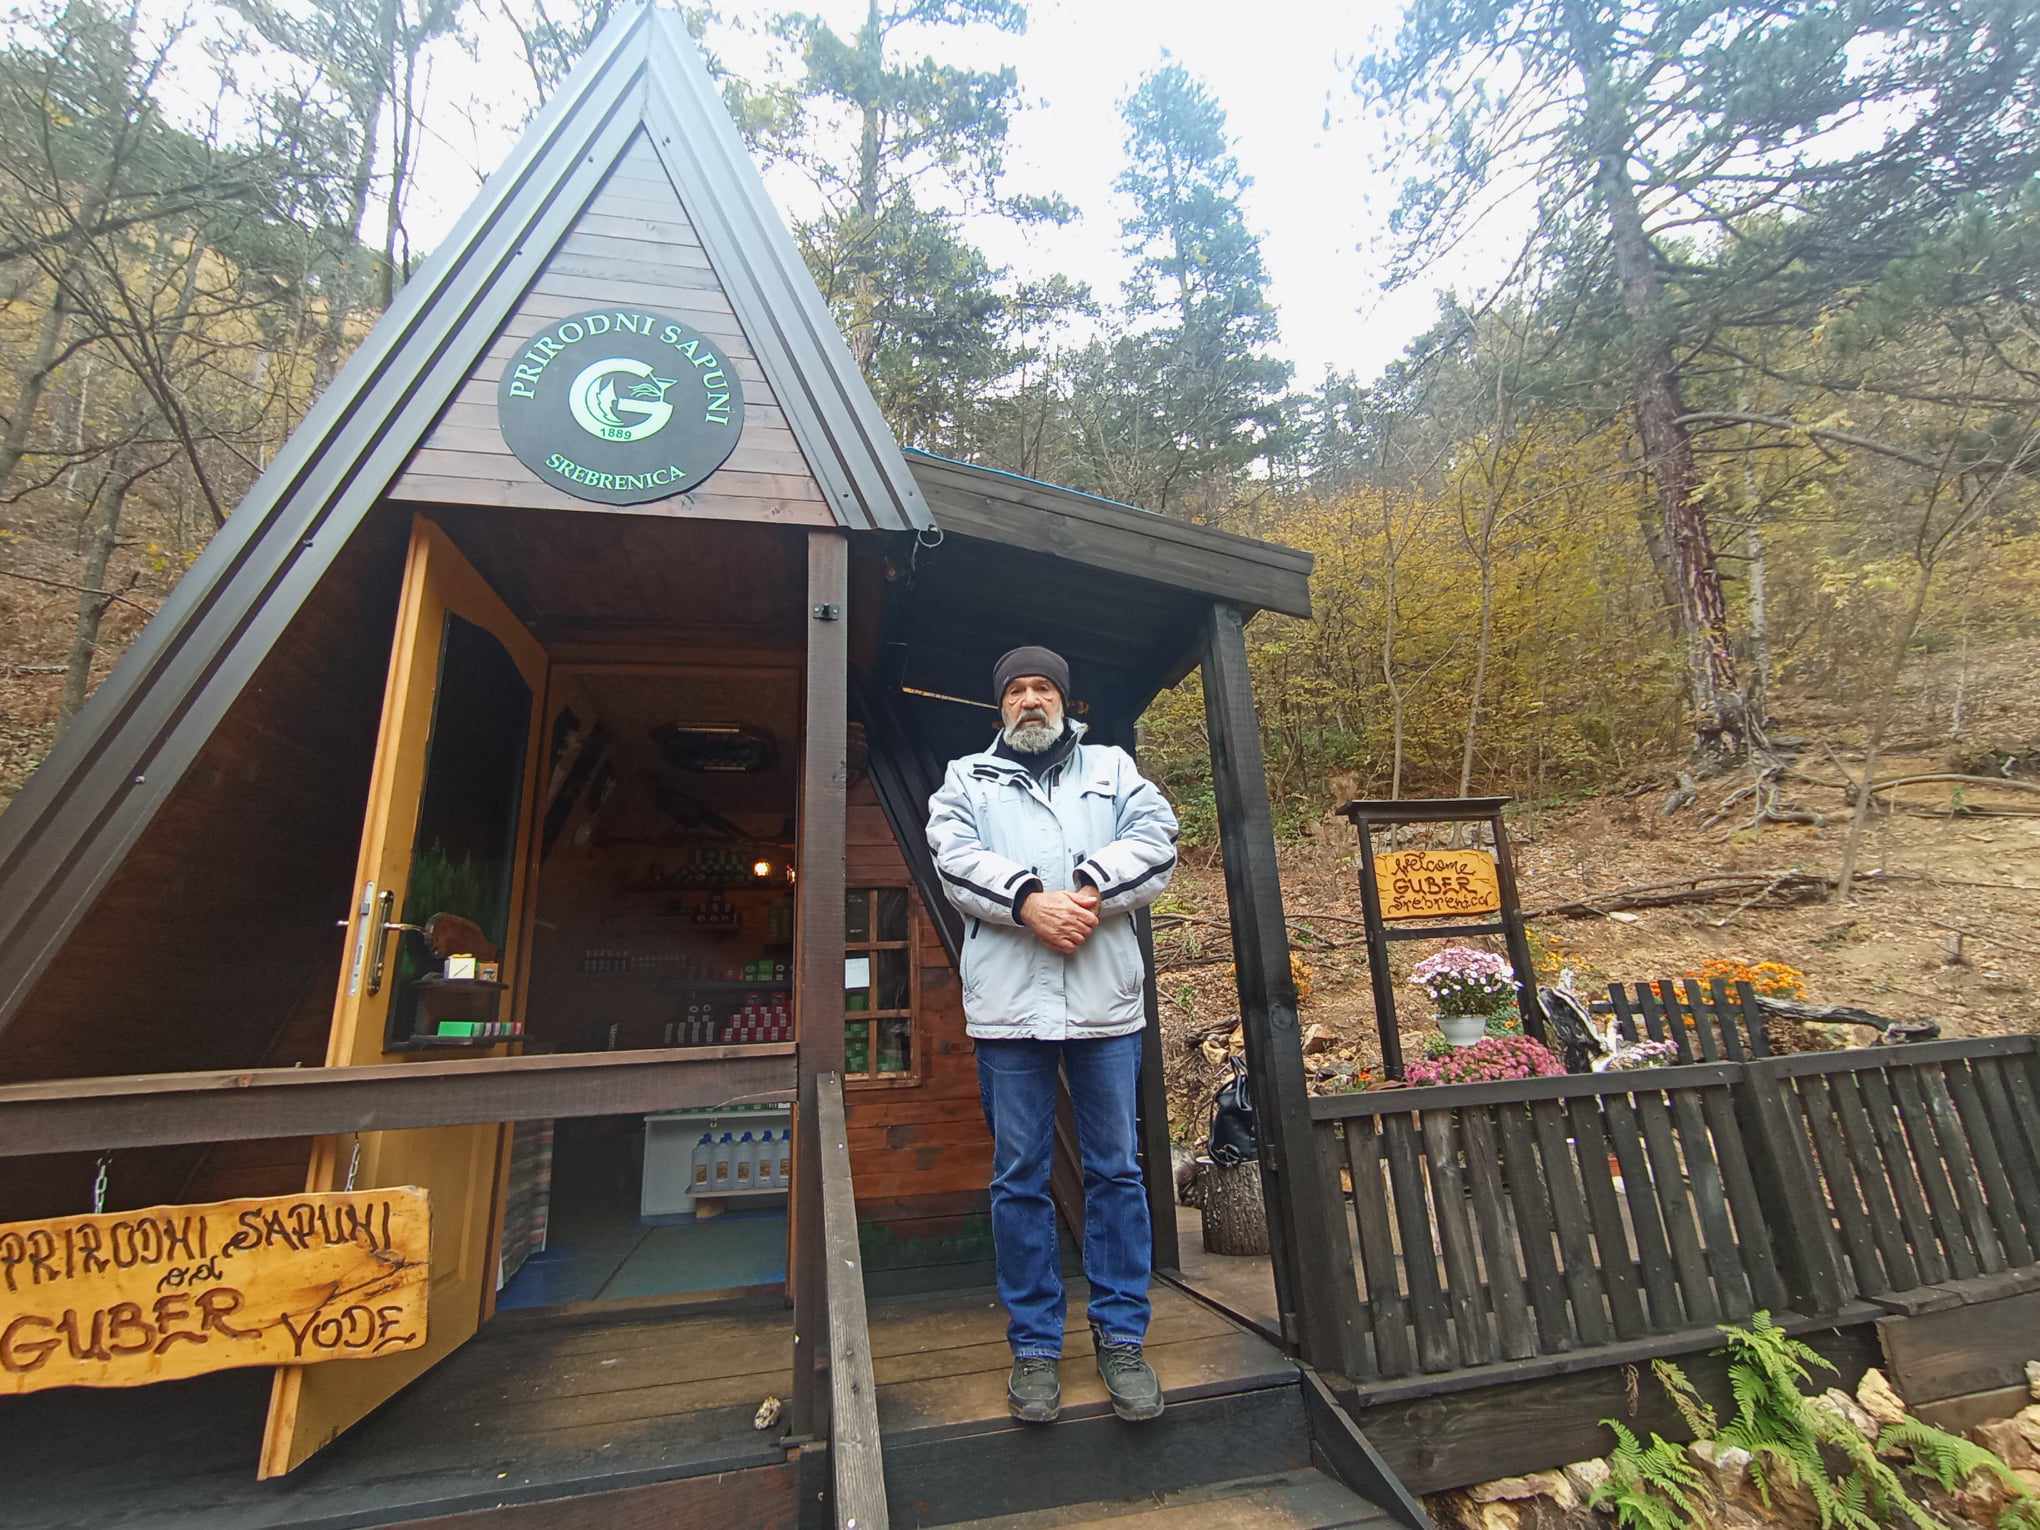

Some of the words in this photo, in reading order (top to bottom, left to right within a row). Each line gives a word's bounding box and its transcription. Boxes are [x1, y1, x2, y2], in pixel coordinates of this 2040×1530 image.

[509, 313, 656, 399] PRIRODNI
[660, 325, 731, 426] SAPUNI
[600, 427, 633, 440] 1889
[545, 453, 687, 490] SREBRENICA
[1392, 876, 1478, 896] GUBER
[0, 1287, 262, 1373] GUBER
